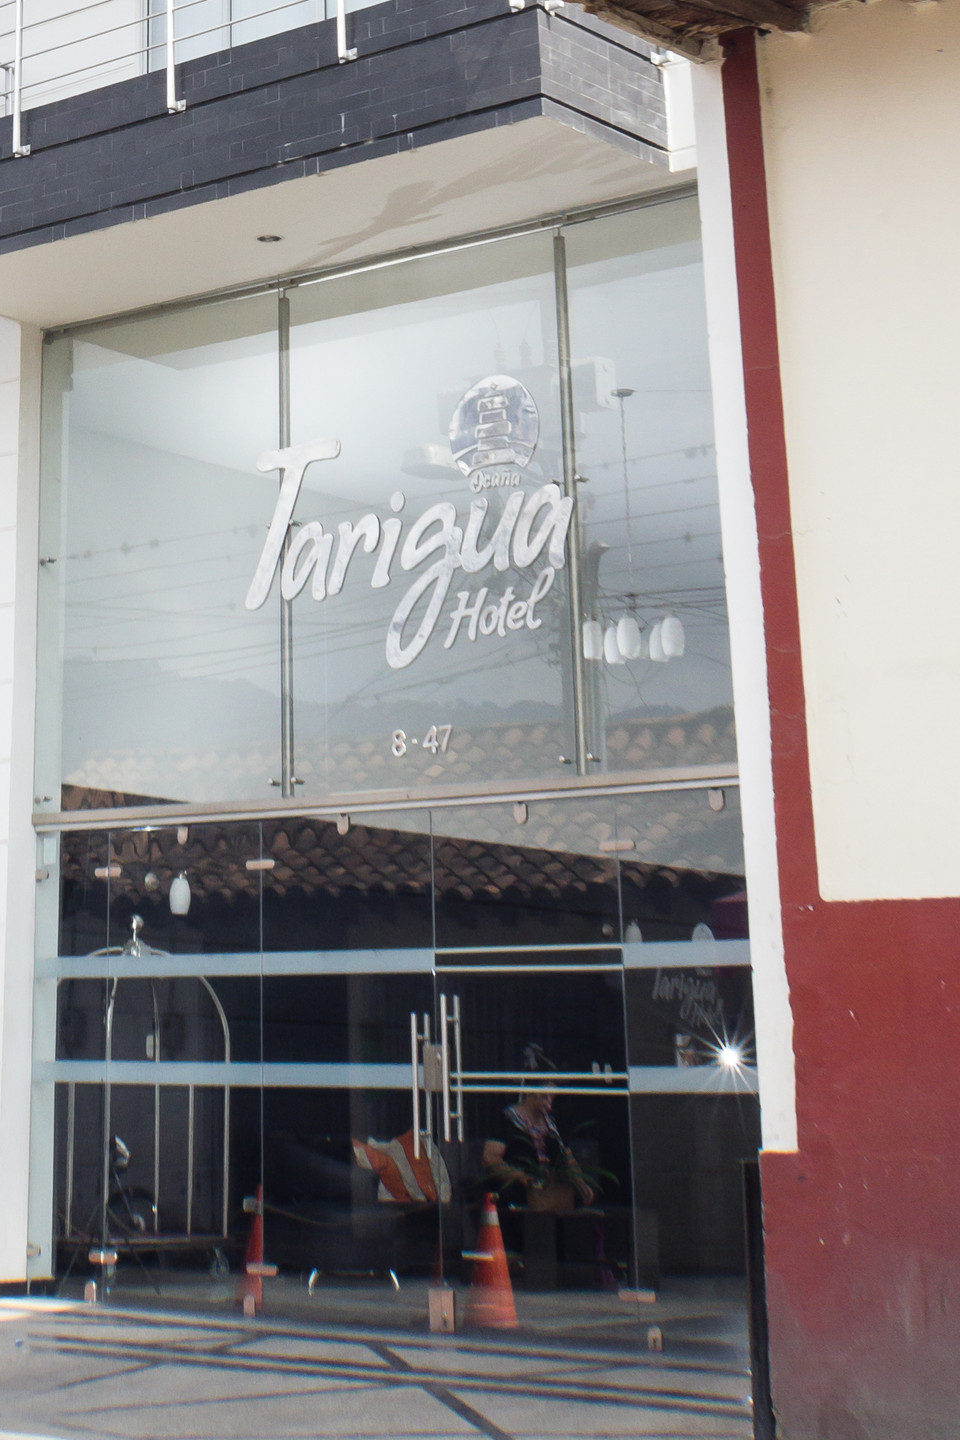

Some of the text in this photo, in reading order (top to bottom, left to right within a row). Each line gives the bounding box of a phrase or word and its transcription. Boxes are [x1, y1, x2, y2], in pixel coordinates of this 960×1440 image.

[470, 469, 520, 493] Ocaña
[245, 439, 574, 669] Tarigua
[444, 567, 555, 649] Hotel
